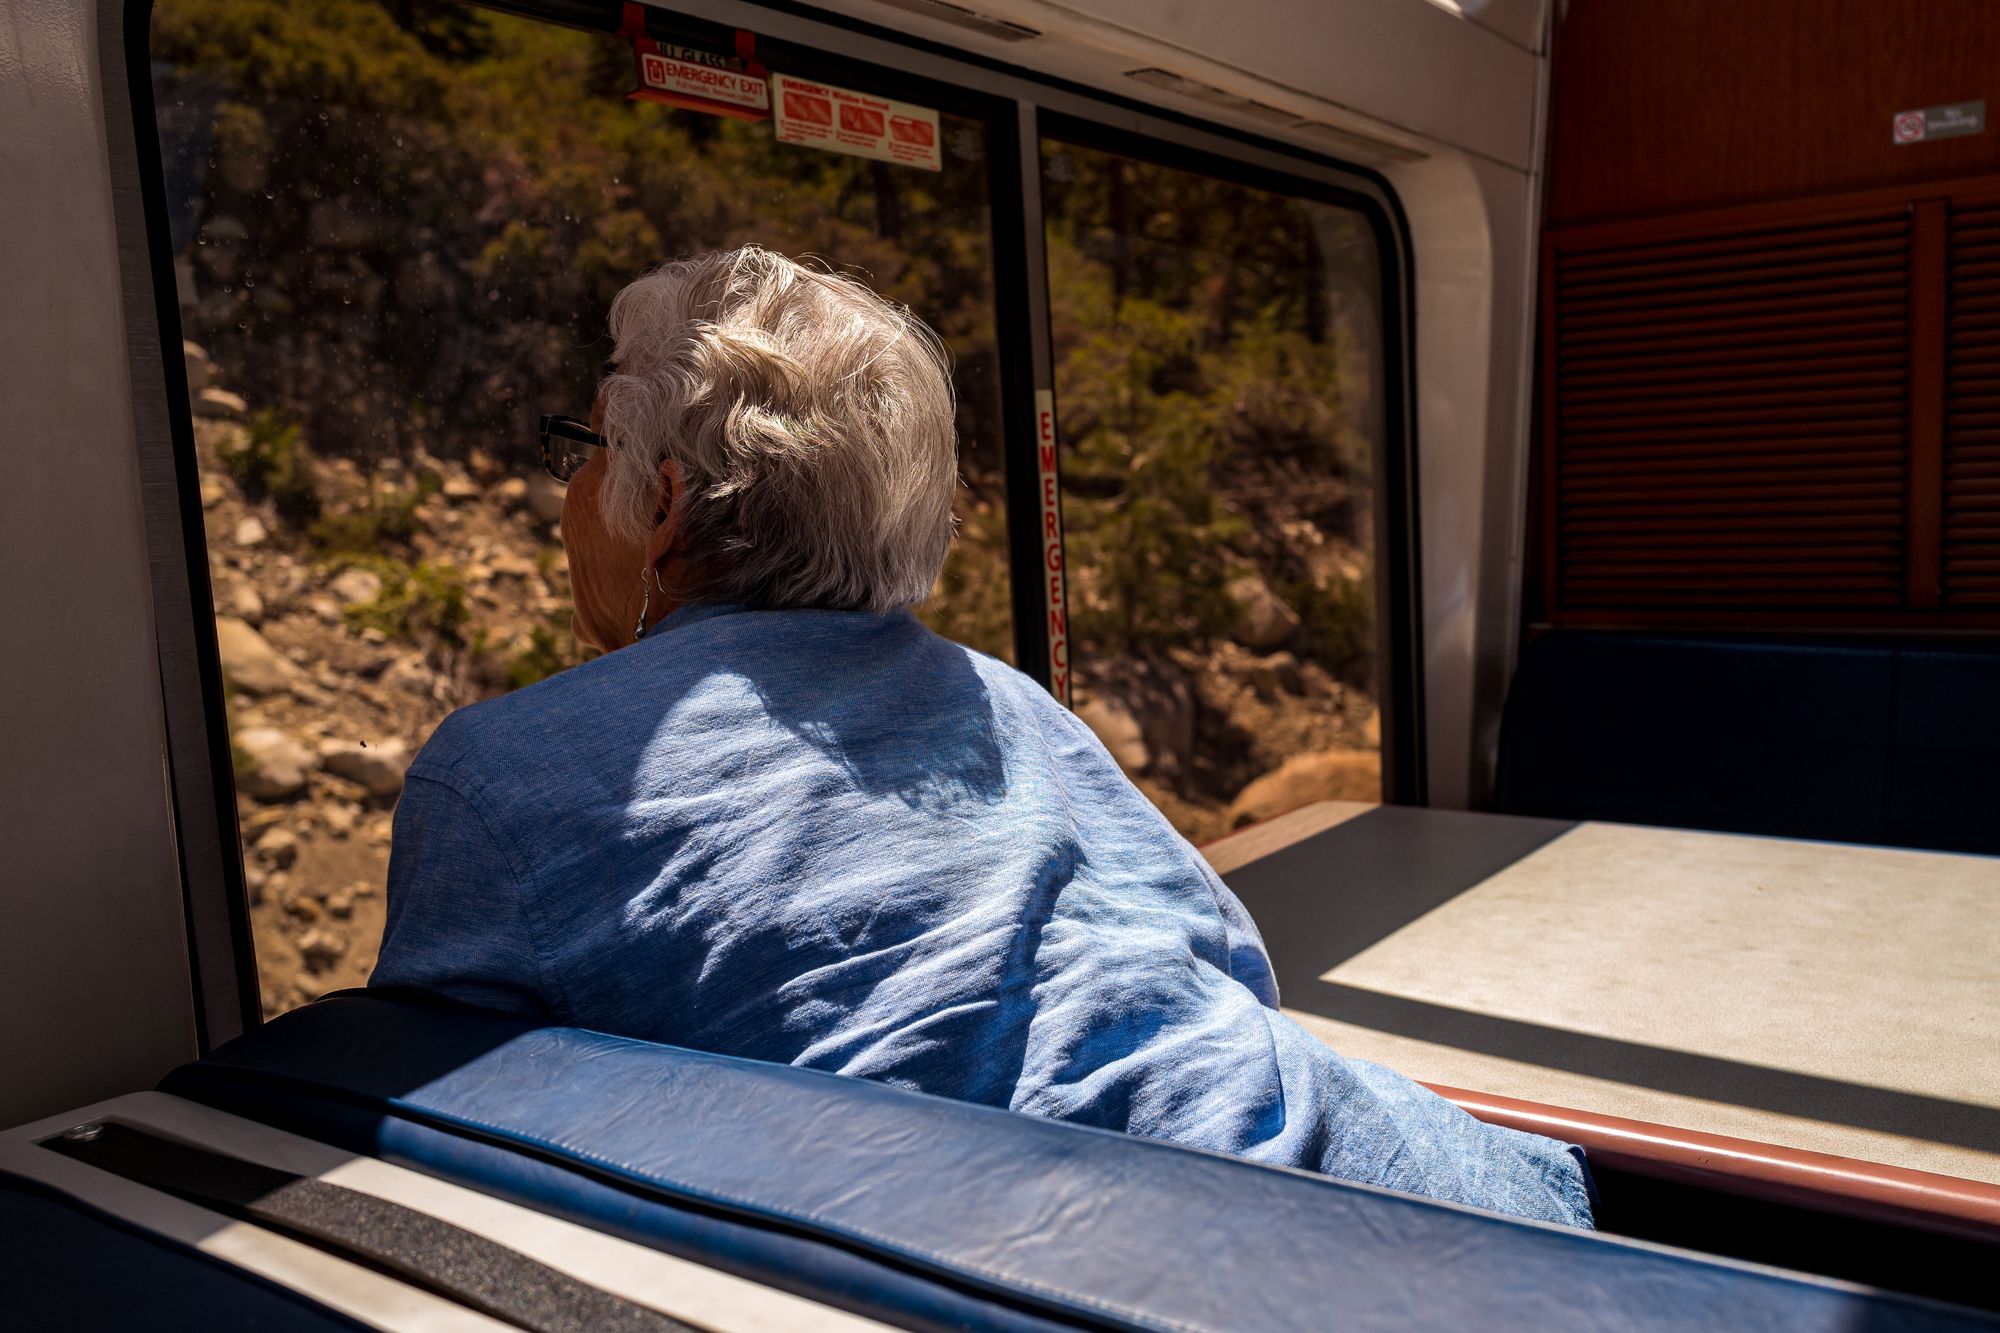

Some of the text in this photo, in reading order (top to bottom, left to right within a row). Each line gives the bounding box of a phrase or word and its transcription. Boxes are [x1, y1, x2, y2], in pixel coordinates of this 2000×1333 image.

[666, 64, 763, 96] EMERGENCY EXIT
[782, 79, 829, 97] EMERGENCY
[832, 91, 860, 103] Window
[1039, 412, 1066, 700] EMERGENCY
